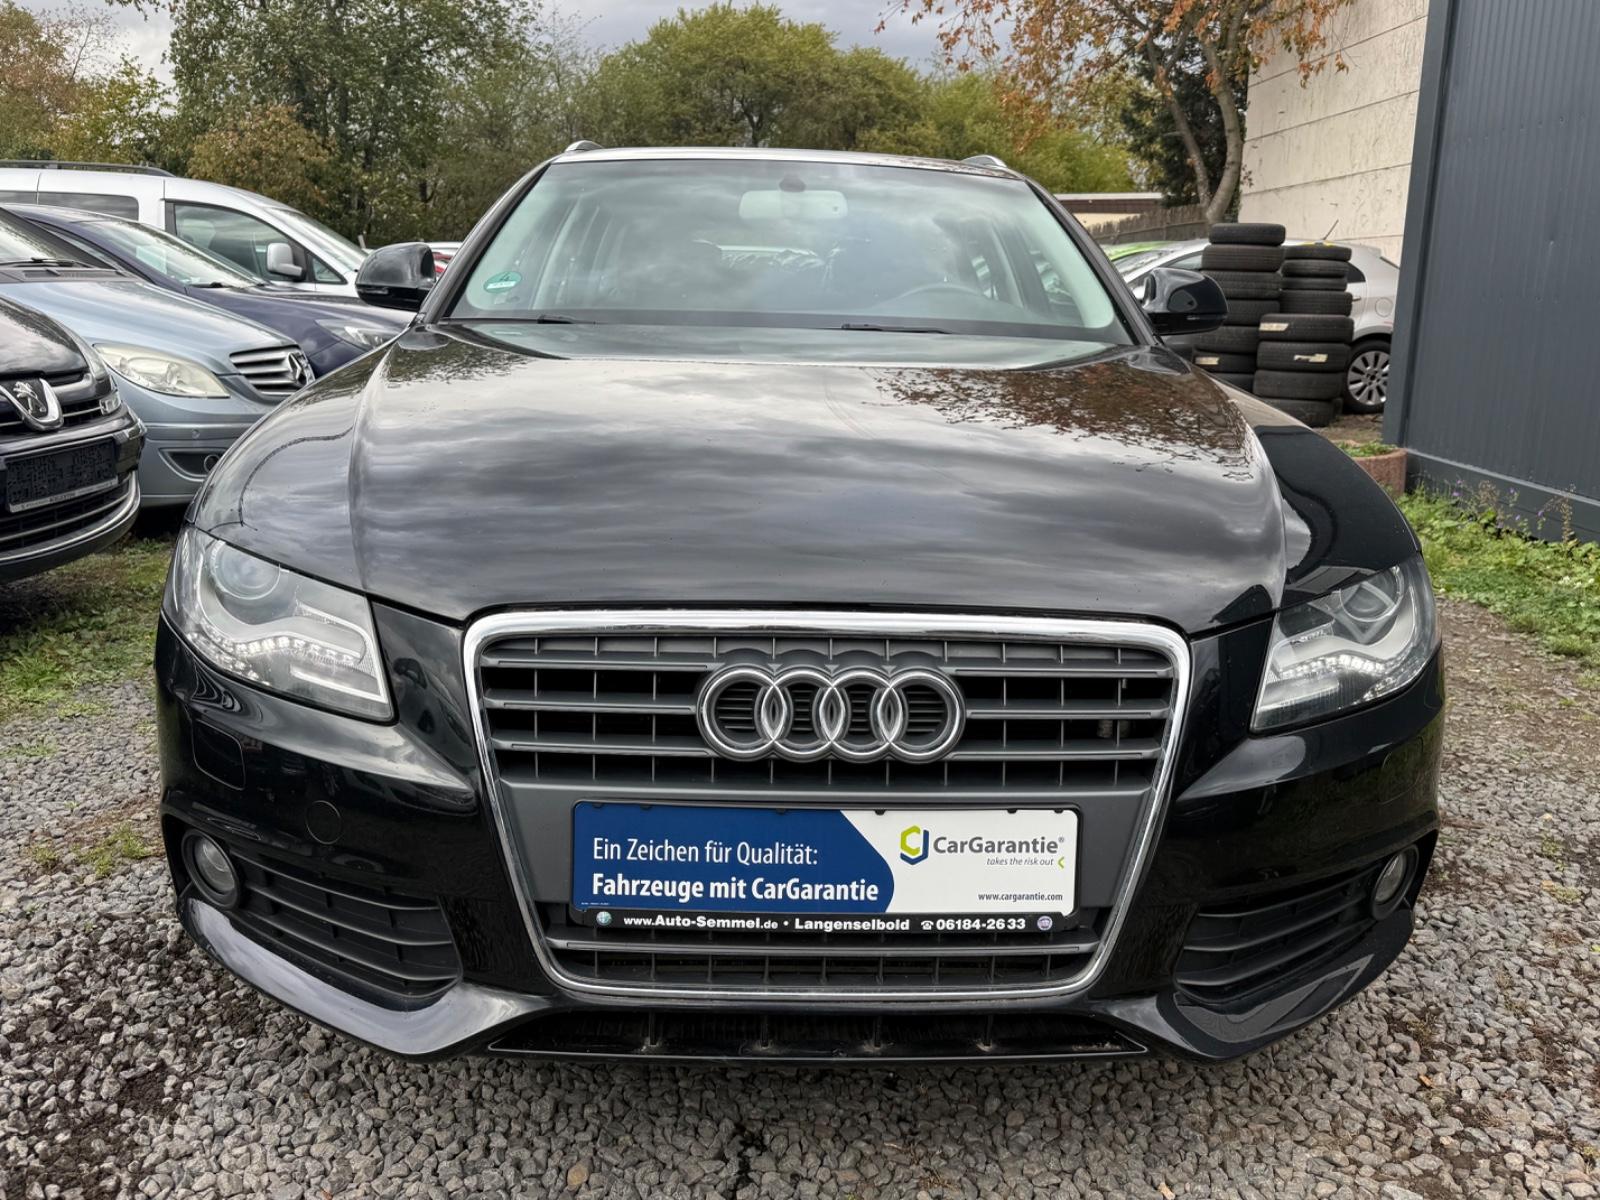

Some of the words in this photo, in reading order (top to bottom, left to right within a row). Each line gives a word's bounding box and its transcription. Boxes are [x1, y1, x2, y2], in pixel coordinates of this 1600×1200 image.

[593, 837, 621, 860] Ein
[626, 838, 699, 862] Zeichen
[704, 839, 732, 863] für
[736, 841, 818, 866] Qualität:
[986, 857, 1008, 866] takes
[1010, 857, 1023, 866] the
[1024, 857, 1039, 866] risk
[1039, 858, 1054, 866] out
[592, 873, 704, 903] Fahrzeuge
[709, 877, 747, 899] mit
[751, 877, 879, 901] CarGarantie
[978, 892, 1063, 902] www.cargarantie.com
[623, 914, 779, 929] www.Auto-Semmel.de
[794, 918, 910, 932] Langenselbold
